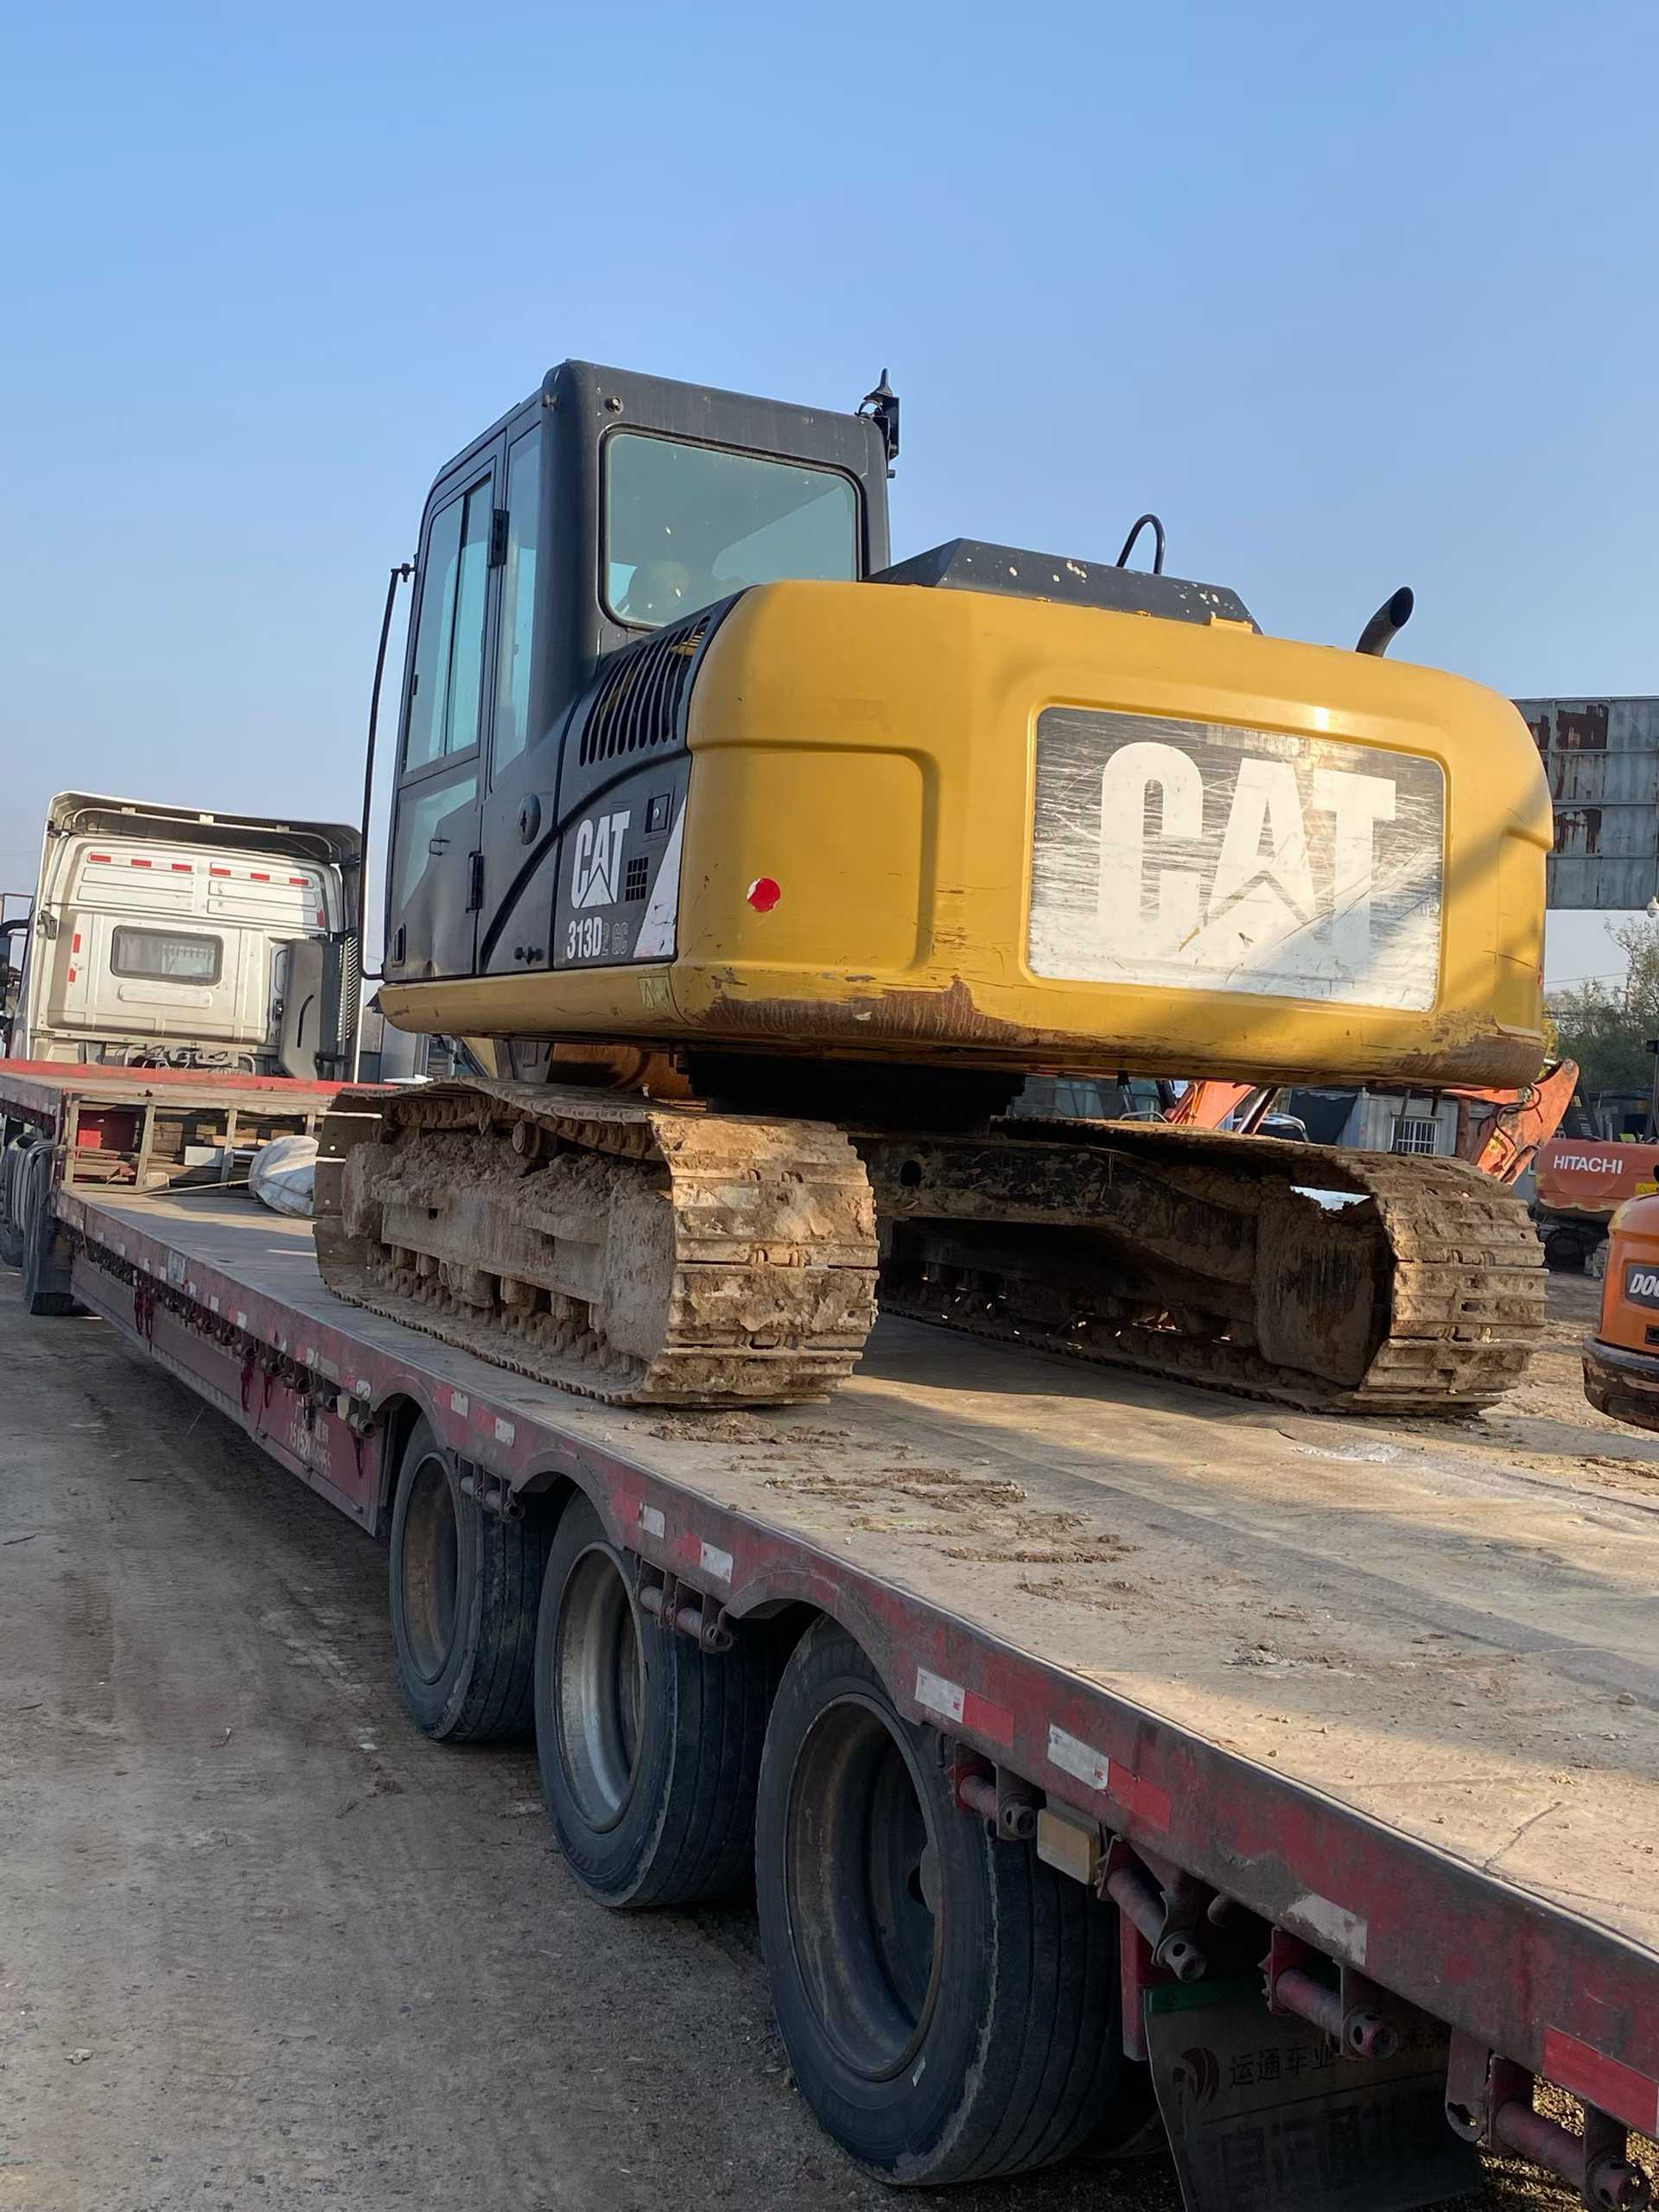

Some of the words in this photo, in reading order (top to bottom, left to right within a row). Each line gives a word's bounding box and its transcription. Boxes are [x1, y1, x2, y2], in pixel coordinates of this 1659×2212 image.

[570, 810, 631, 909] CAT
[1096, 741, 1396, 989] CAT
[1553, 1154, 1624, 1175] HITACHI
